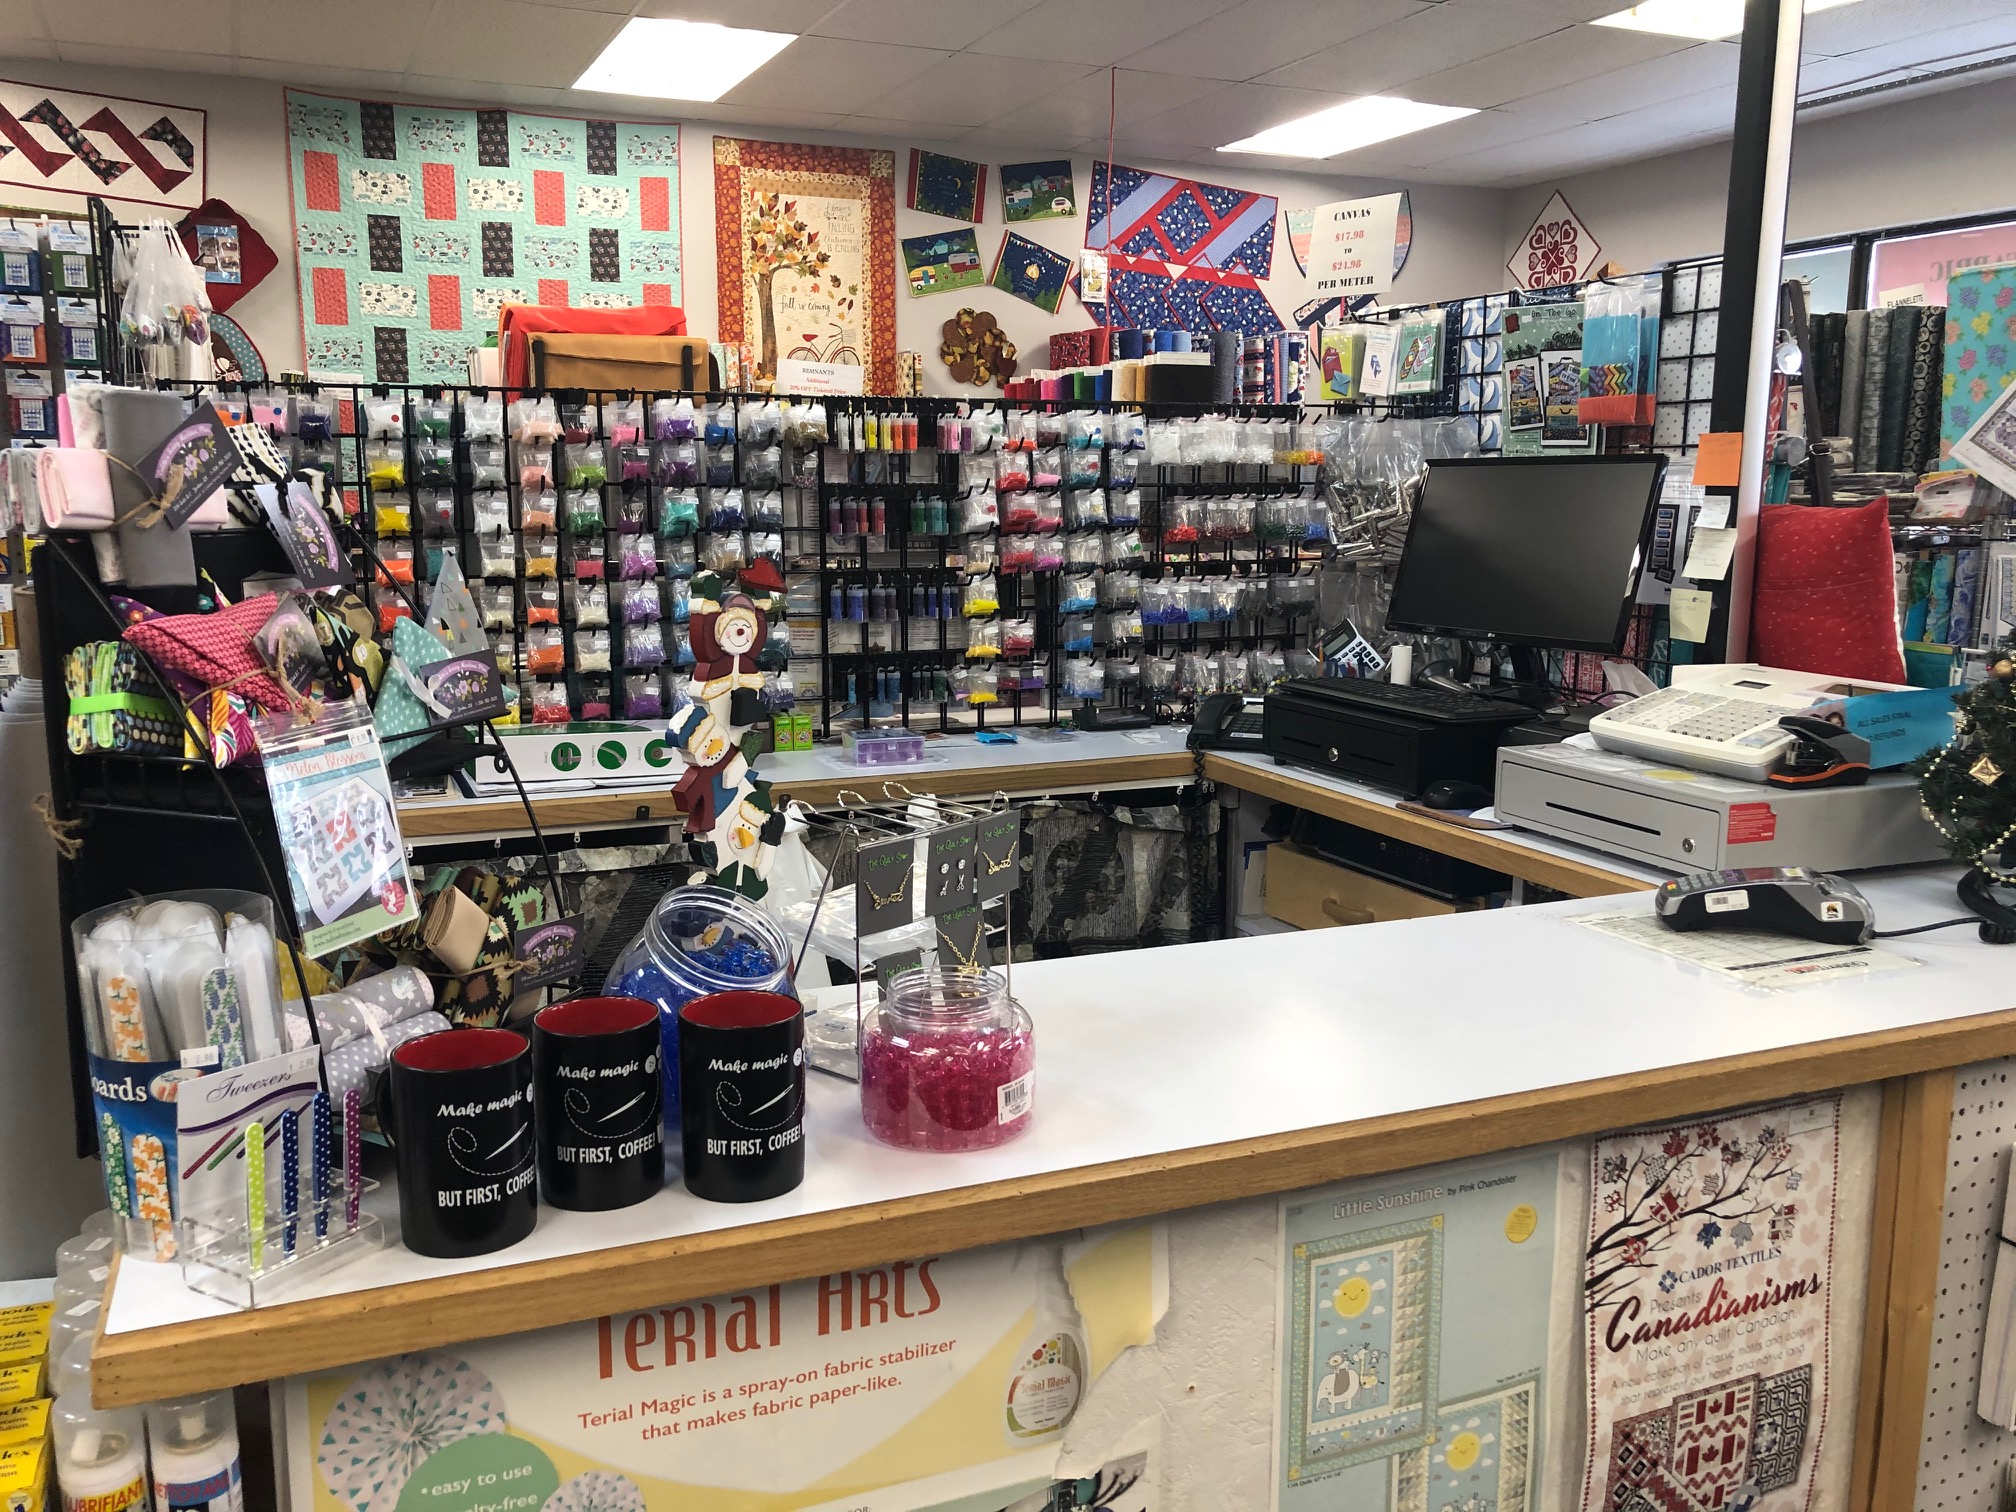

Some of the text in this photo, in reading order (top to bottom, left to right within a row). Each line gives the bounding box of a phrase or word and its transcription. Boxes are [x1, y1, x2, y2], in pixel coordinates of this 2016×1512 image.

[1333, 207, 1372, 222] CANVAS
[1334, 229, 1365, 243] $17.98
[1344, 247, 1353, 255] TO
[1331, 259, 1362, 272] $21.98
[1317, 275, 1374, 290] PER METER
[1545, 308, 1561, 317] The
[1565, 306, 1577, 318] Go
[801, 367, 835, 376] REMNANTS
[805, 377, 830, 385] Additional
[1857, 720, 1870, 728] ALL
[1870, 714, 1891, 726] SALES
[1874, 728, 1906, 741] REFUNDS
[285, 751, 367, 776] Melon Blossom
[556, 1060, 640, 1081] Make magic
[708, 1053, 789, 1074] Make magic
[206, 1071, 293, 1104] Tweezers
[437, 1089, 523, 1118] Make magic
[557, 1131, 656, 1164] BUT FIRST, COFFEE!
[707, 1124, 801, 1156] BUT FIRST, COFFEE!
[438, 1190, 463, 1207] BUT
[465, 1183, 502, 1206] FIRST,
[1446, 1174, 1518, 1197] by Pink Chandelier
[1332, 1199, 1374, 1220] Little
[1376, 1184, 1444, 1210] Sunshine
[1679, 1247, 1783, 1284] CADOR TEXTILES
[1605, 1272, 1823, 1353] Canadianisms
[1636, 1345, 1672, 1363] Make
[1677, 1338, 1700, 1354] any
[1704, 1325, 1731, 1346] quilt
[1644, 1359, 1691, 1384] collection
[1705, 1349, 1735, 1367] classic
[1765, 1334, 1783, 1348] and
[577, 1339, 957, 1429] Terial Magic is a spray-on fabric stabilizer
[1621, 1393, 1641, 1406] that
[1644, 1380, 1689, 1400] represent
[1708, 1365, 1733, 1379] home
[1736, 1359, 1755, 1373] and
[1756, 1350, 1784, 1368] native
[641, 1375, 902, 1441] that makes fabric paper-like.
[431, 1465, 533, 1496] easy to use
